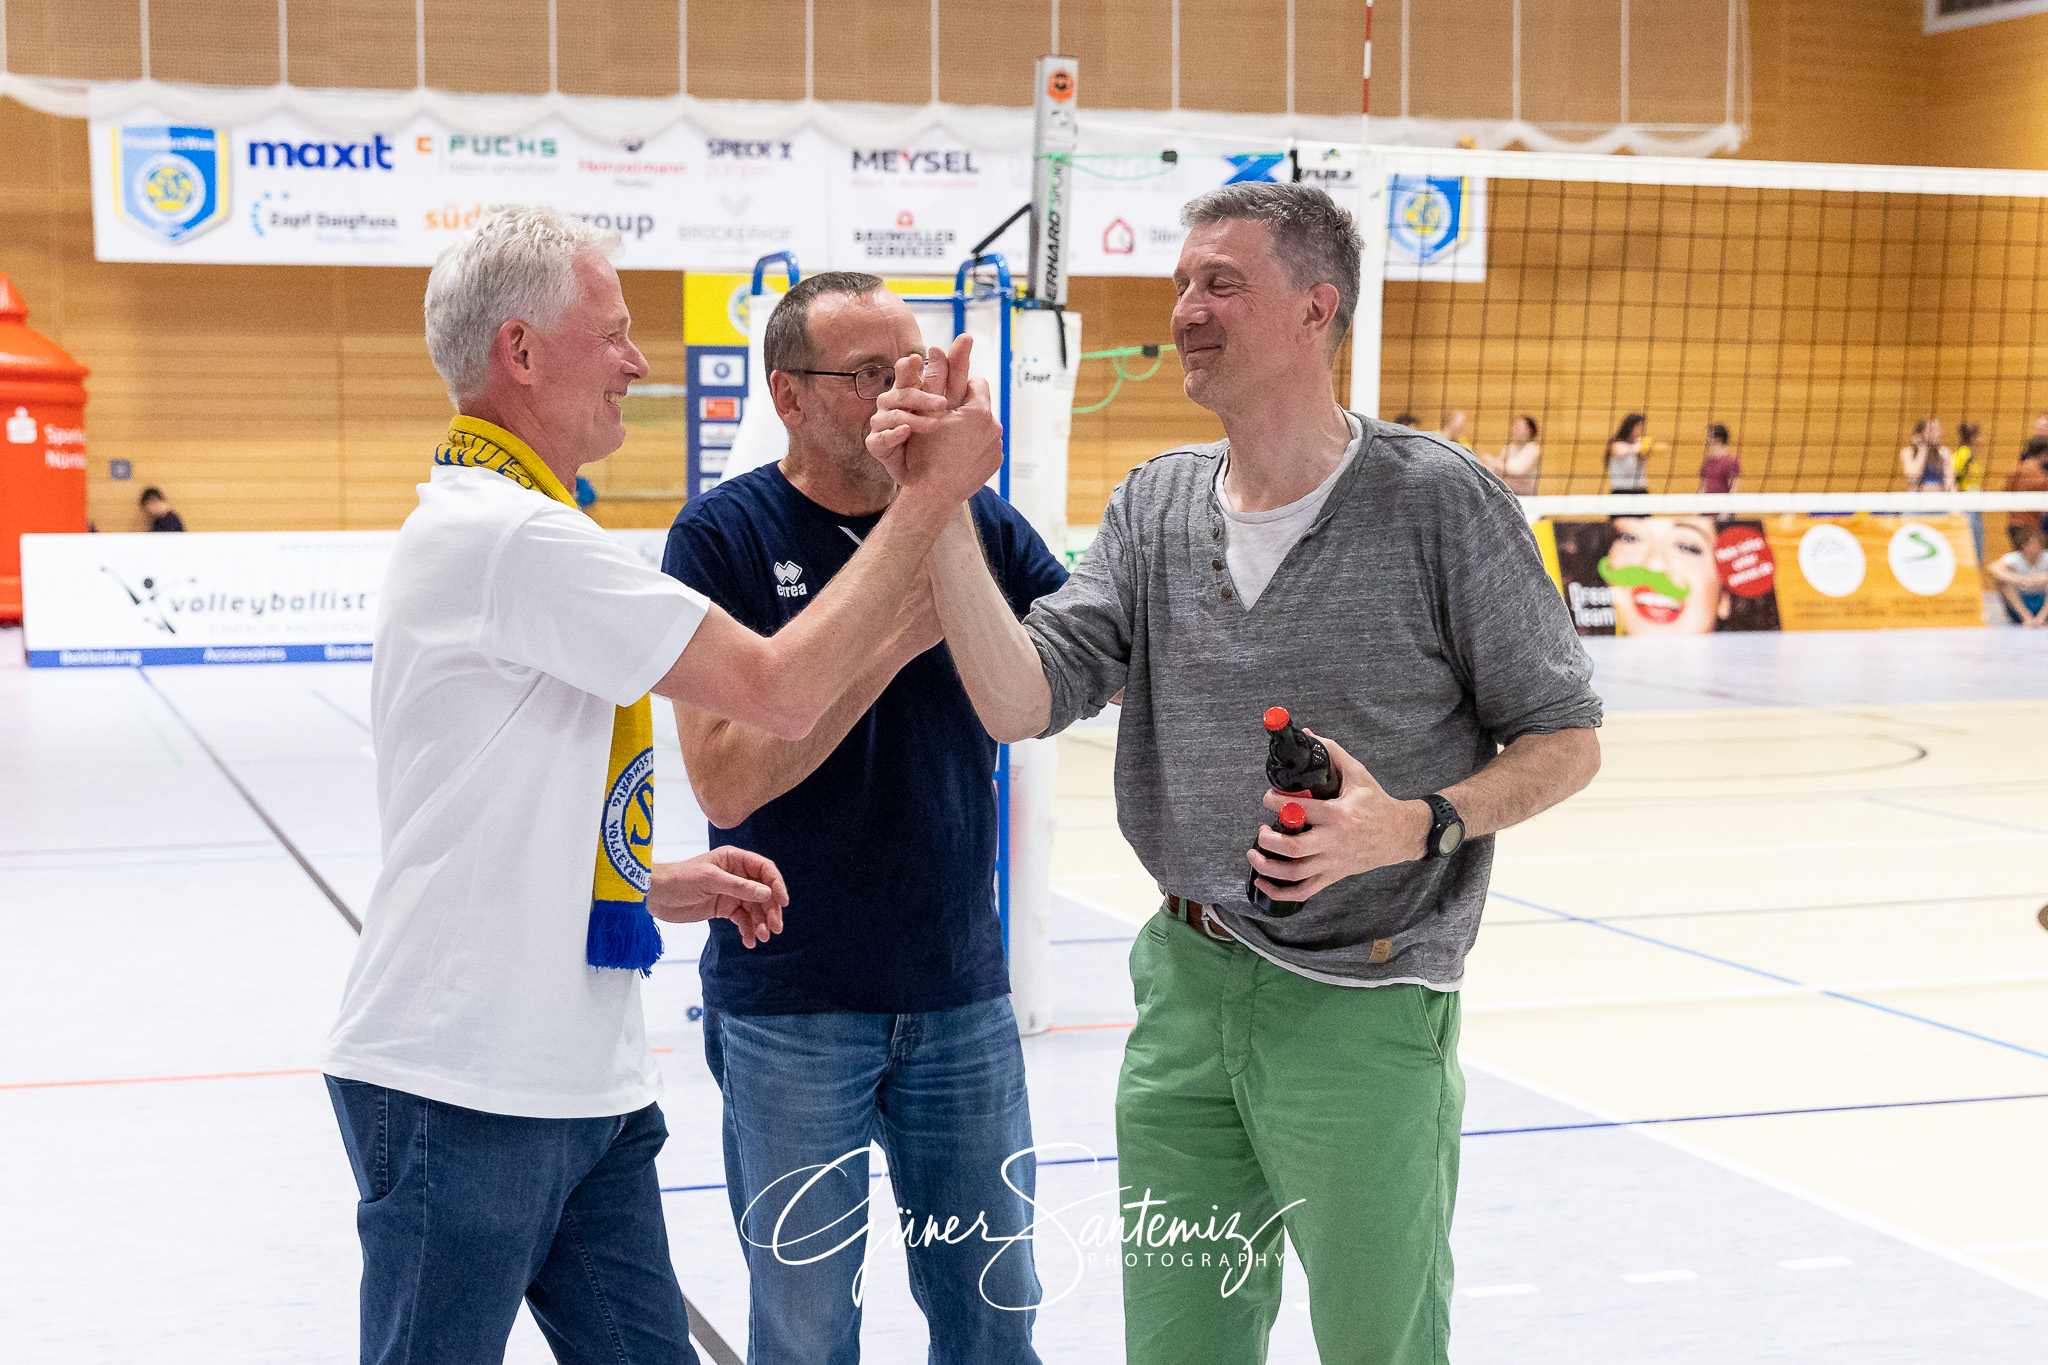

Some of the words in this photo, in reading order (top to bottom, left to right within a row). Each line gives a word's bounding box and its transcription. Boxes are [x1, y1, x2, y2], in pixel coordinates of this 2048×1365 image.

[249, 133, 393, 169] maxit
[449, 136, 557, 157] FUCHS
[852, 150, 979, 173] MEYSEL
[777, 583, 807, 598] errea
[170, 592, 367, 616] volleyballist
